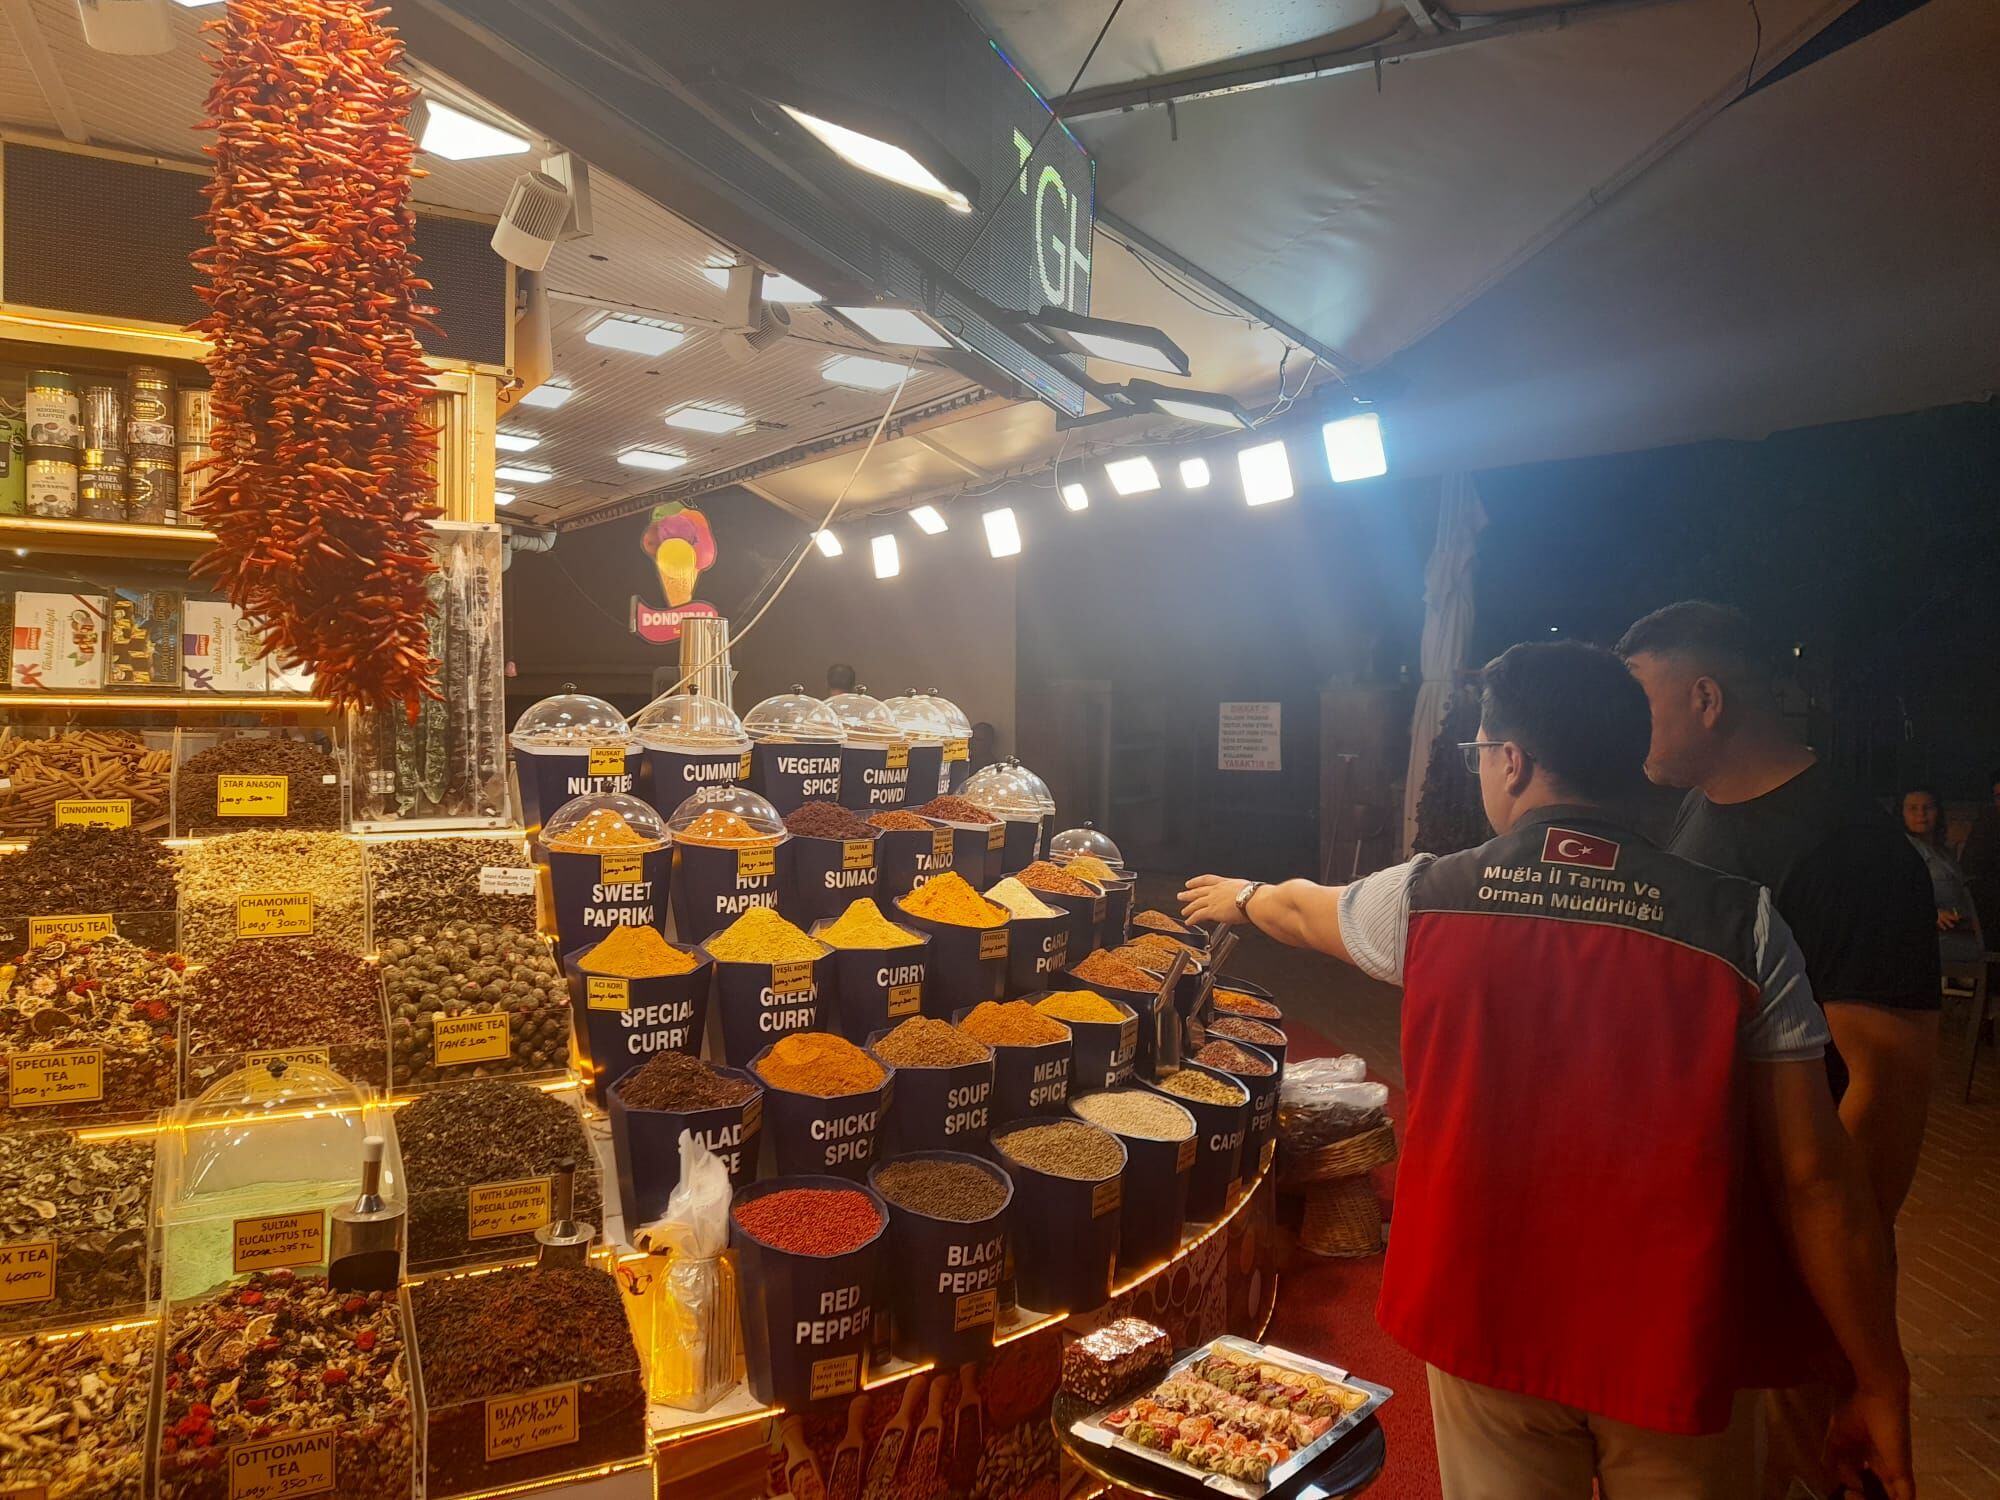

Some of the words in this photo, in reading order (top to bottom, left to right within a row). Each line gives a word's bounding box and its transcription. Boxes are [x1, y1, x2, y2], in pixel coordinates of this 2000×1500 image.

[215, 616, 225, 646] Delight
[223, 780, 243, 788] STAR
[246, 780, 282, 789] ANASON
[567, 773, 632, 795] NUTMEG
[803, 777, 839, 796] SPICE
[61, 806, 108, 814] CINNOMON
[592, 882, 652, 903] SWEET
[736, 872, 768, 889] HOT
[1483, 866, 1542, 883] Muğla
[1568, 872, 1625, 893] Tarım
[1633, 881, 1660, 899] Ve
[265, 909, 285, 917] TEA
[716, 889, 778, 914] PAPRIKA
[1478, 885, 1544, 906] Orman
[1550, 892, 1664, 922] Müdürlüğü
[34, 922, 85, 934] HIBISCUS
[87, 921, 107, 932] TEA
[583, 905, 654, 927] PAPRIKA
[877, 963, 925, 987] CURRY
[760, 980, 818, 1006] GREEN
[620, 999, 694, 1028] SPECIAL
[759, 1006, 817, 1032] CURRY
[439, 1021, 483, 1036] JASMINE
[486, 1019, 504, 1029] TEA
[628, 1024, 690, 1055] CURRY
[439, 1037, 466, 1051] TANE
[16, 1057, 67, 1070] SPECIAL
[70, 1055, 96, 1066] TAD
[1033, 1057, 1070, 1083] MEAT
[44, 1072, 68, 1082] TEA
[948, 1082, 990, 1109] SOUP
[1029, 1081, 1068, 1107] SPICE
[944, 1107, 988, 1135] SPICE
[678, 1123, 742, 1151] ALAD
[480, 1190, 502, 1200] WITH
[504, 1185, 542, 1198] SAFFRON
[474, 1203, 506, 1214] SPECIAL
[509, 1199, 528, 1210] LOVE
[530, 1197, 545, 1206] TEA
[239, 1230, 299, 1246] EUCALYPTUS
[301, 1228, 320, 1238] TEA
[261, 1219, 298, 1231] SULTAN
[18, 1249, 48, 1262] TEA
[947, 1234, 1003, 1267] BLACK
[938, 1260, 1003, 1294] PEPPER
[820, 1285, 860, 1314] RED
[796, 1305, 871, 1345] PEPPER
[496, 1400, 538, 1420] BLACK
[544, 1395, 568, 1409] TEA
[236, 1437, 330, 1467] OTTOMAN
[267, 1461, 299, 1479] TEA
